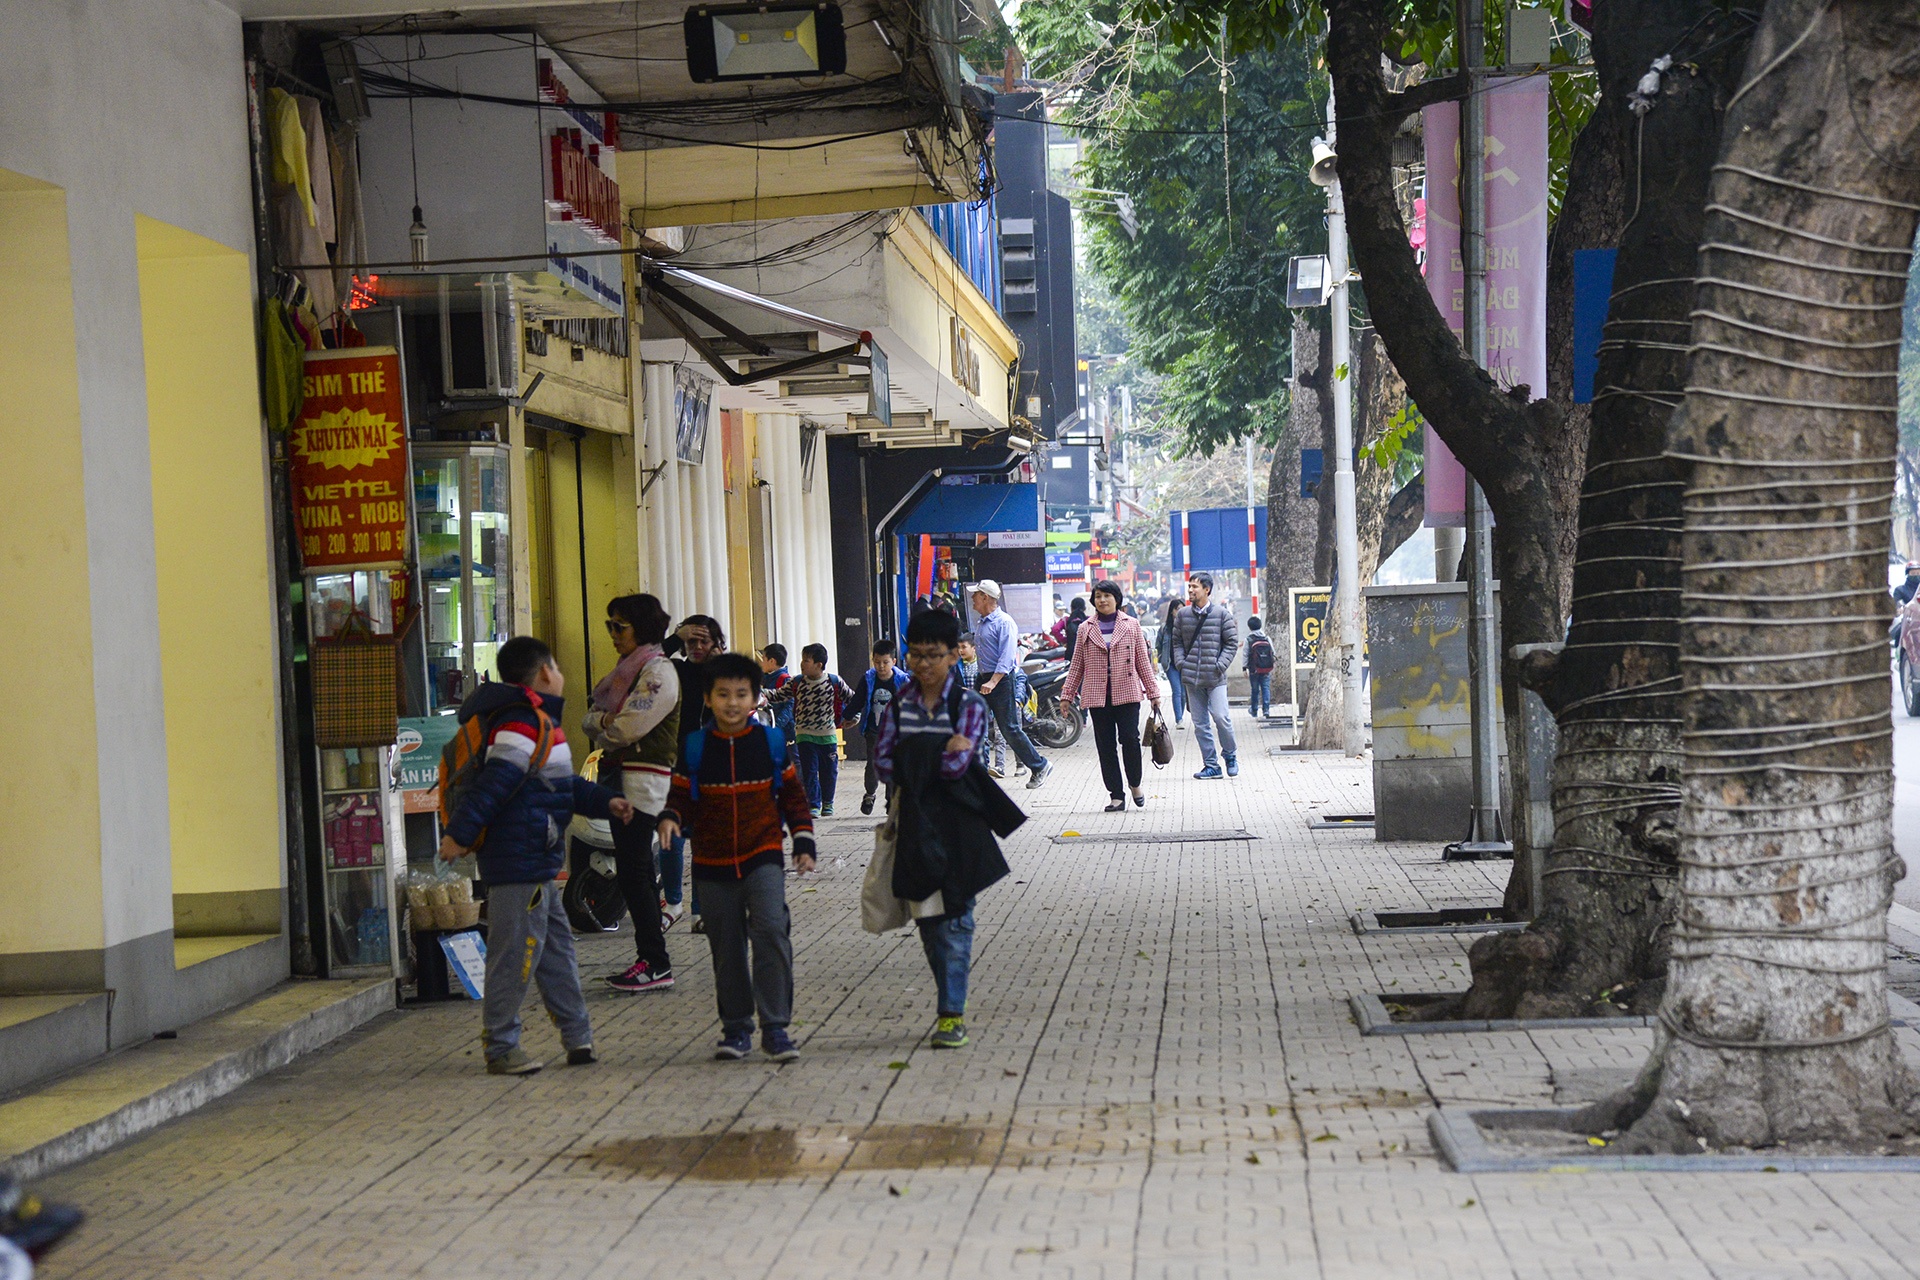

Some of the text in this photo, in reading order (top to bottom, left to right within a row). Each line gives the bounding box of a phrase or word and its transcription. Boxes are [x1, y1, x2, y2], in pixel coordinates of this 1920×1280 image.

[303, 362, 386, 397] SIM THẺ
[362, 424, 388, 454] MẠI
[303, 479, 397, 500] VIETTEL
[300, 505, 342, 529] VINA
[360, 501, 405, 524] MOBI
[328, 533, 346, 555] 200
[353, 532, 370, 553] 300
[374, 530, 392, 551] 100
[390, 579, 406, 600] BI
[401, 765, 439, 784] ÁN HÀ
